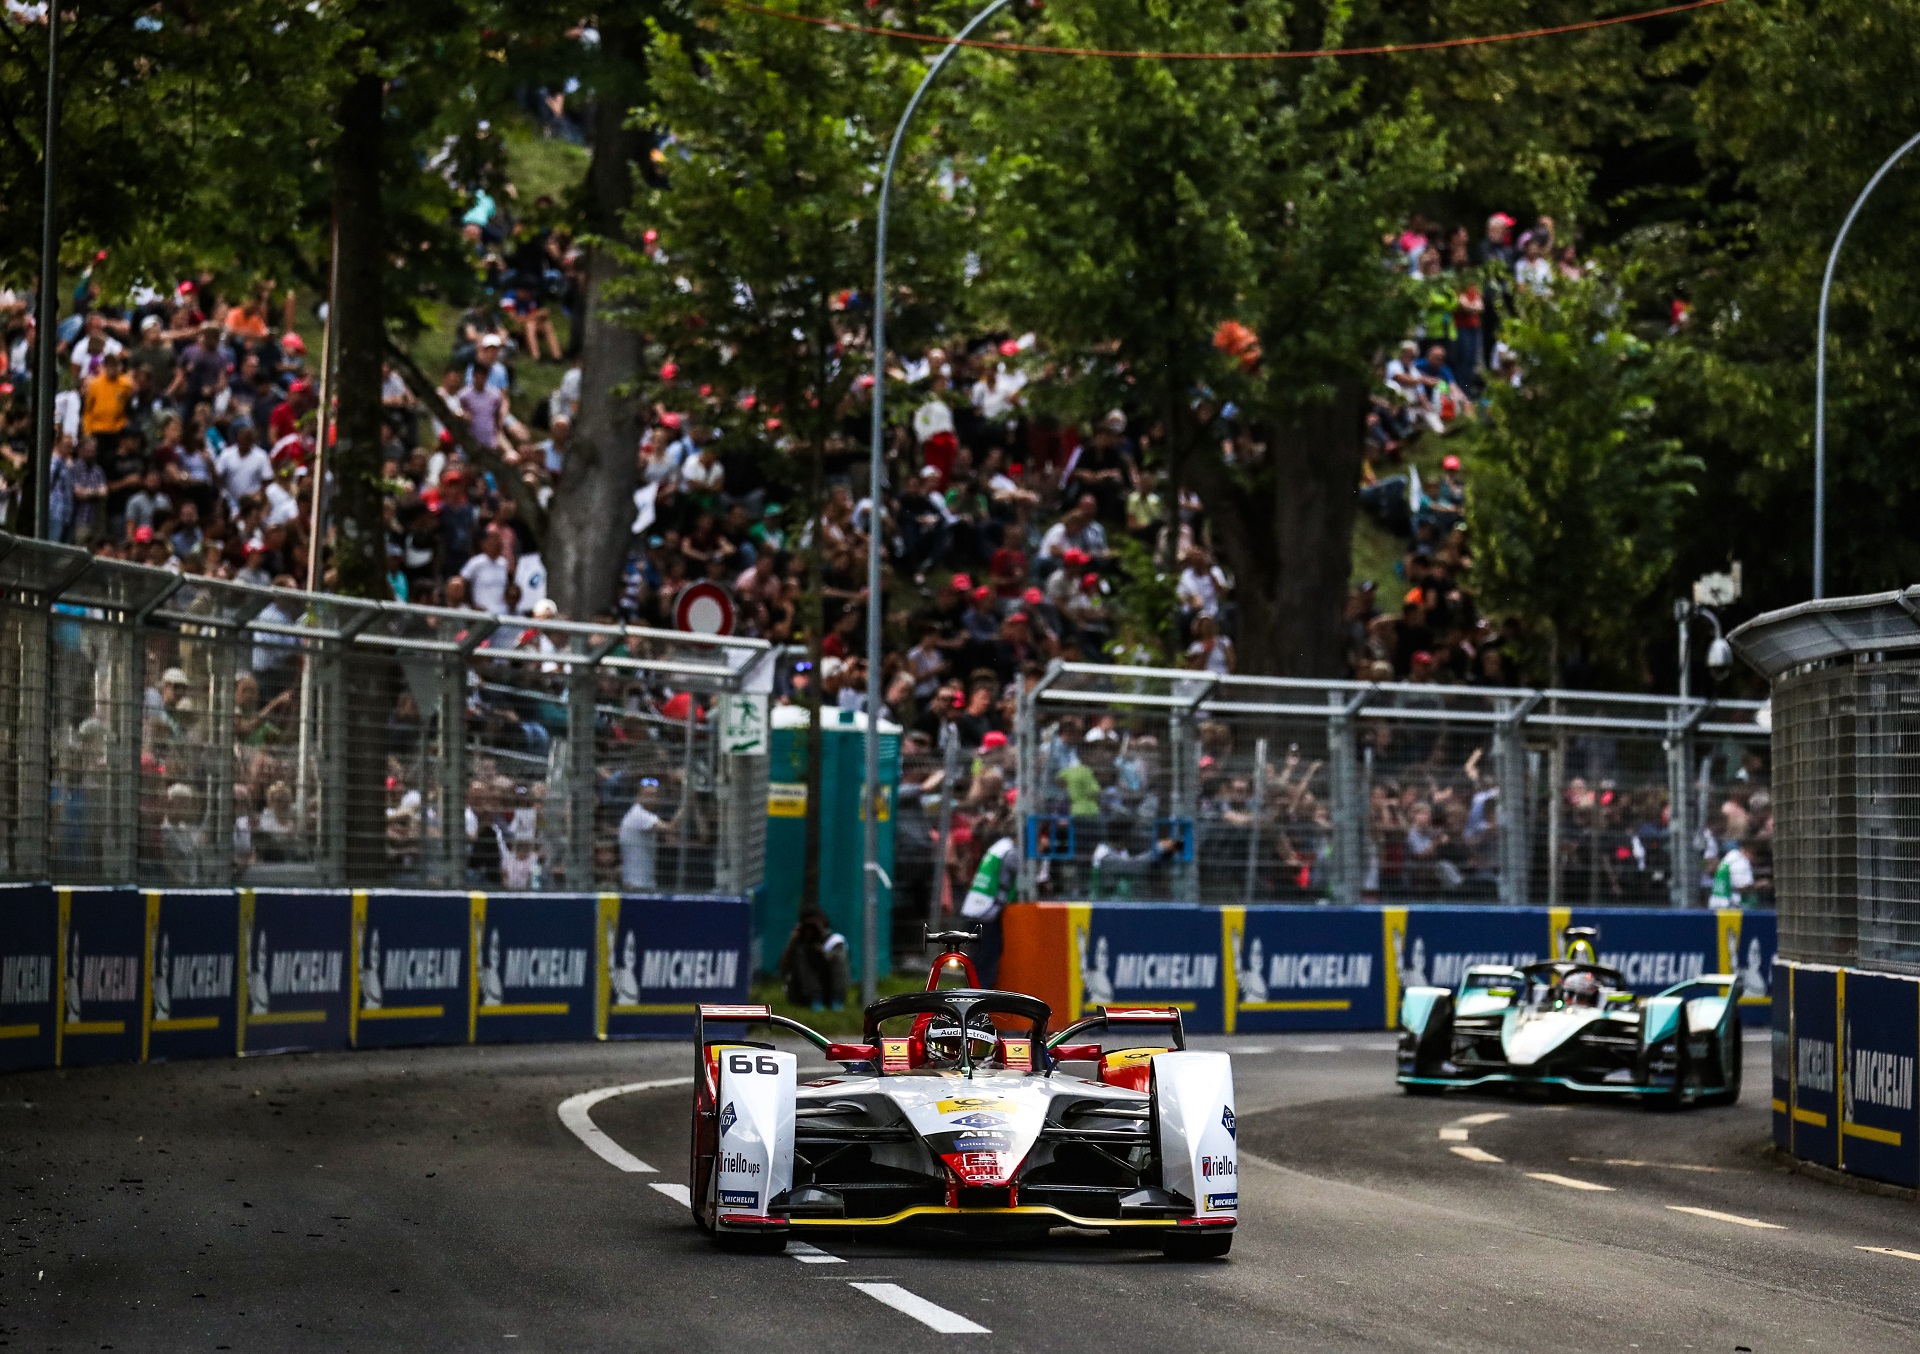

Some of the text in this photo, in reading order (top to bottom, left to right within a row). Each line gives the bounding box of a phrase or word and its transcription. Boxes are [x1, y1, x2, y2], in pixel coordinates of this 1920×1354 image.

[384, 948, 461, 989] MICHELIN
[504, 948, 587, 988] MICHELIN
[641, 950, 739, 988] MICHELIN
[1114, 954, 1218, 988] MICHELIN
[1268, 954, 1372, 988] MICHELIN
[729, 1054, 779, 1075] 66
[1855, 1049, 1913, 1110] MICHELIN
[723, 1152, 760, 1177] riello ups
[1212, 1155, 1233, 1176] riello
[724, 1195, 756, 1204] MICHELIN
